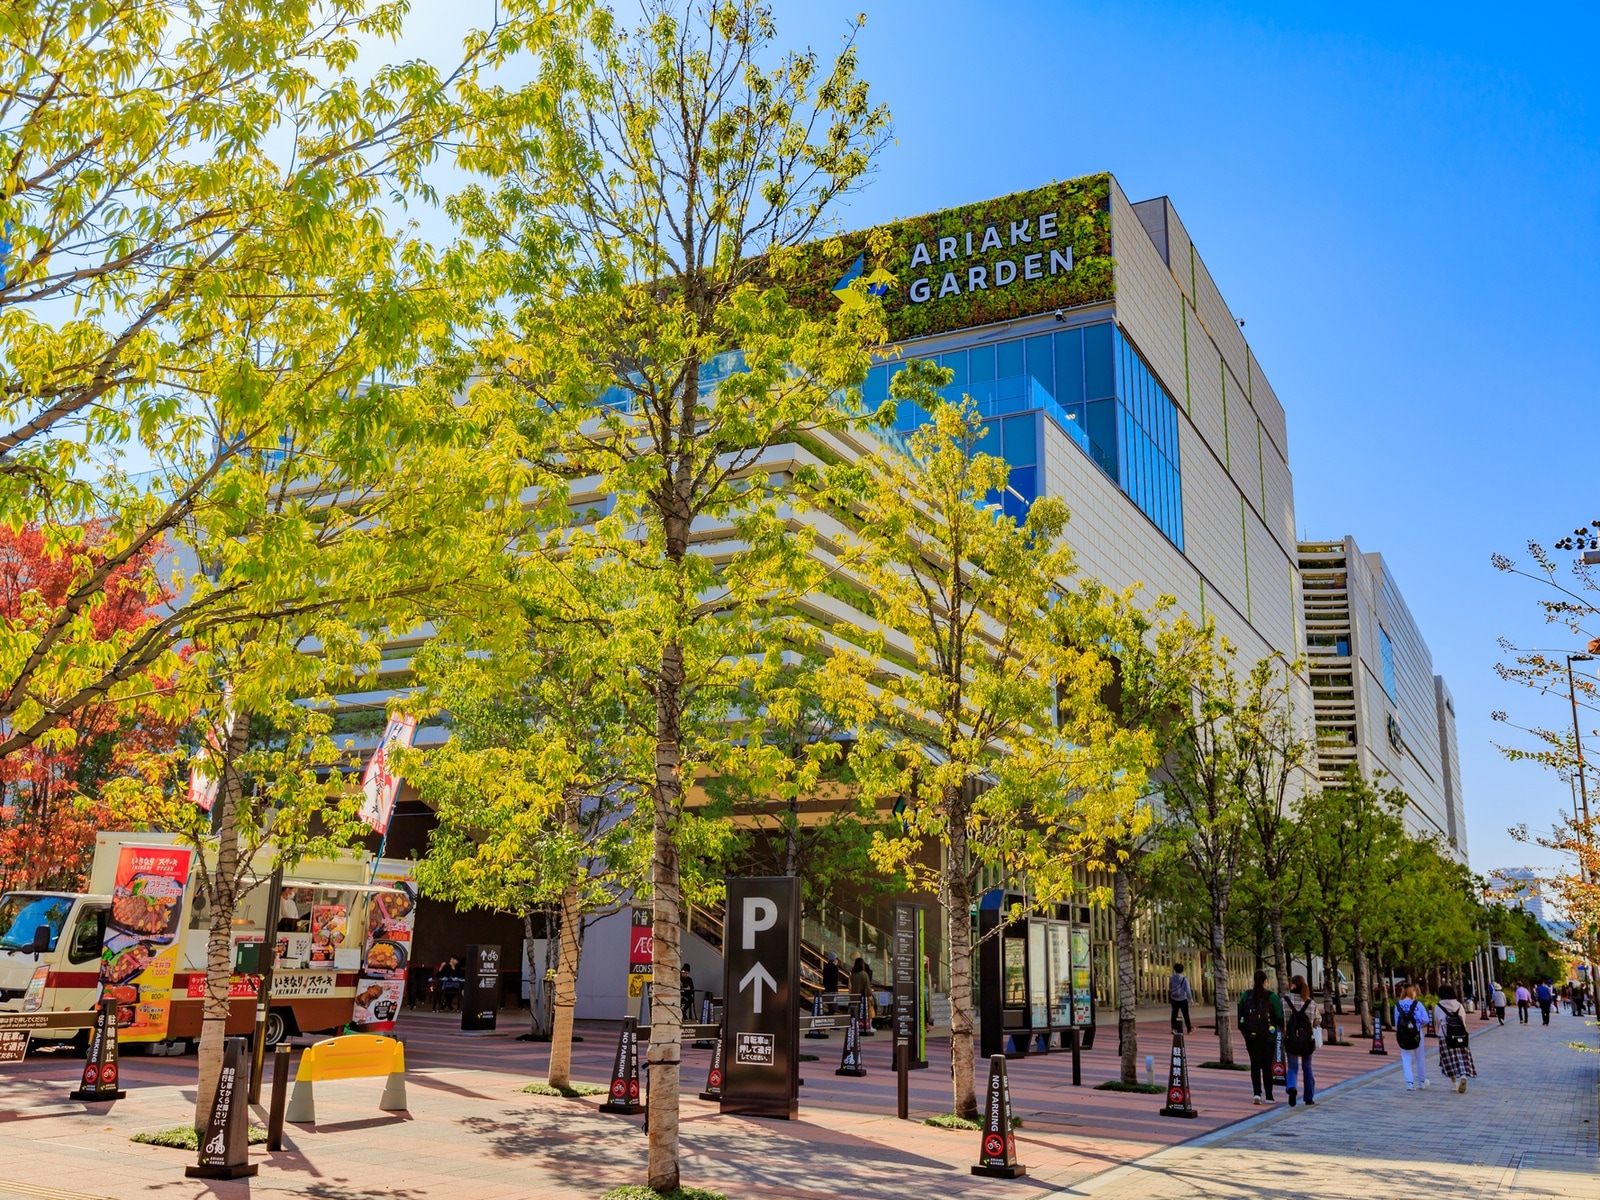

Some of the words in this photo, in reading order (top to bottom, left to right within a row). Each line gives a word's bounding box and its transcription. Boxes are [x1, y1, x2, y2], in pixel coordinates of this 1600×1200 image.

[910, 212, 1058, 269] ARIAKE
[909, 246, 1074, 303] GARDEN
[742, 897, 778, 949] P
[274, 975, 303, 988] いきなり
[309, 976, 333, 986] ステーキ
[97, 1014, 105, 1027] NO
[623, 1031, 629, 1044] NO
[91, 1028, 103, 1063] PARKING
[105, 1014, 117, 1063] 駐輪禁止
[739, 1045, 772, 1055] 押して通行
[743, 1036, 769, 1044] 自転車は
[617, 1044, 627, 1078] PARKING
[213, 1067, 229, 1126] 通行してください
[220, 1068, 236, 1126] 自転車から降りて
[992, 1075, 999, 1090] NO
[990, 1091, 999, 1132] PARKING
